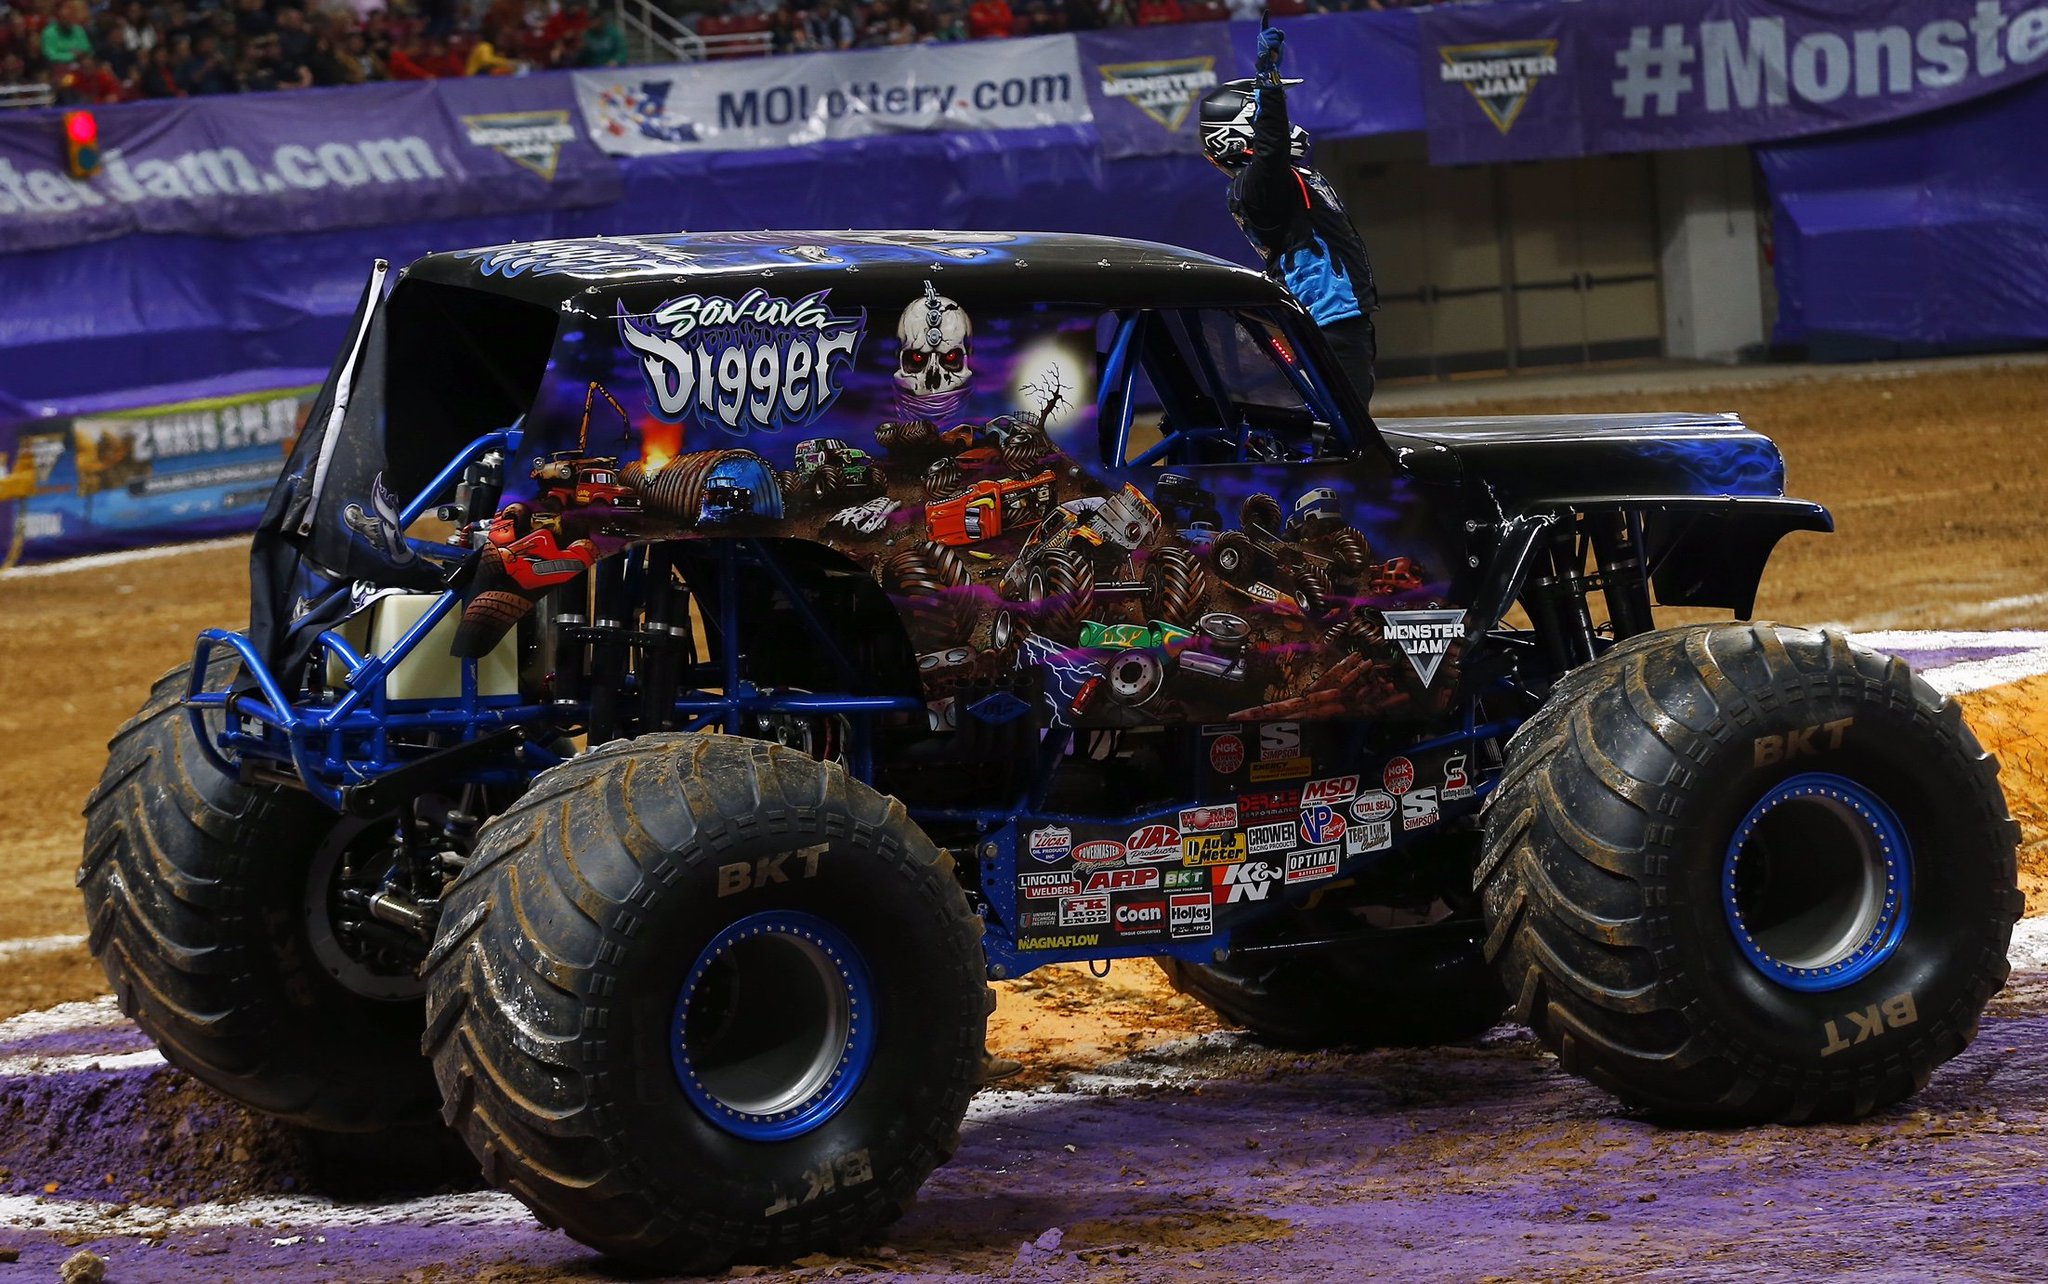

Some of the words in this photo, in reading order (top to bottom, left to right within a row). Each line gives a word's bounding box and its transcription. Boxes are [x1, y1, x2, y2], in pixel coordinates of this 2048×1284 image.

[1441, 54, 1557, 82] MONSTER
[1475, 75, 1528, 98] JAM
[717, 72, 1072, 130] MOLottery.com
[623, 322, 858, 427] Digger
[1383, 623, 1465, 640] MONSTER
[1407, 639, 1443, 654] JAM
[1215, 743, 1238, 754] NGK
[1754, 717, 1855, 768] BKT
[1261, 748, 1298, 761] SIMPSON
[1388, 763, 1409, 777] NGK
[1304, 776, 1357, 801] MSD
[1355, 801, 1375, 813] TOTAL
[1375, 799, 1391, 810] SEAL
[1301, 806, 1333, 844] VP
[1404, 812, 1440, 829] SIMPSON
[1035, 837, 1068, 847] LUCAS
[1128, 825, 1181, 850] JAZ
[1249, 823, 1295, 846] CROWER
[1079, 844, 1120, 860] POWERMASTER
[1130, 846, 1180, 859] Products
[1200, 848, 1243, 862] Meter
[1250, 844, 1269, 852] RACING
[1269, 841, 1296, 850] PRODUCTS
[1290, 850, 1335, 869] OPTIMA
[718, 842, 830, 898] BKT
[1087, 868, 1158, 889] ARP
[1165, 871, 1203, 884] BKT
[1020, 874, 1070, 887] LINCOLN
[1031, 885, 1075, 896] WELDERS
[1226, 880, 1271, 904] N
[1062, 916, 1107, 925] ENDS
[1073, 910, 1107, 918] ROD
[1116, 905, 1162, 923] Coan
[1172, 905, 1211, 923] Holley
[1017, 934, 1099, 951] MAGNAFLOW
[1820, 991, 1918, 1057] BKT
